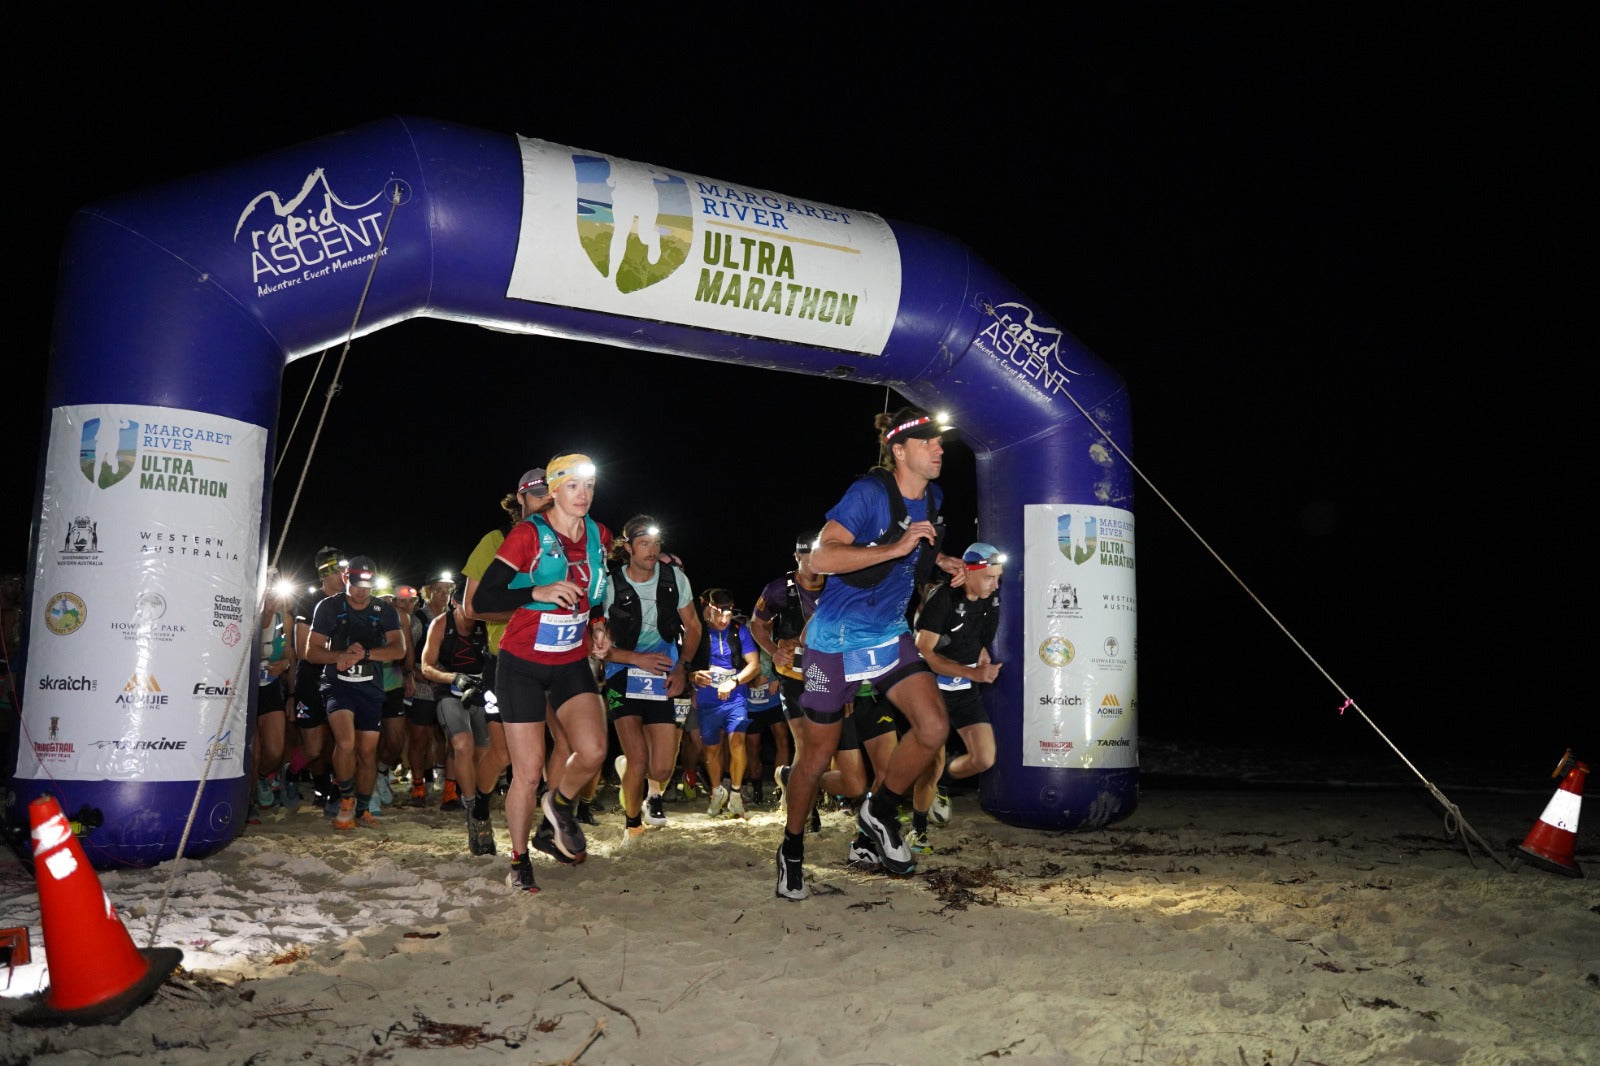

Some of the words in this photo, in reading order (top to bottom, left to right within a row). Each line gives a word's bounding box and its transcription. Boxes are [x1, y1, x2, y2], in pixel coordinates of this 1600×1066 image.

[695, 181, 851, 225] MARGARET
[251, 193, 338, 249] rapid
[702, 197, 789, 230] RIVER
[251, 212, 382, 283] ASCENT
[702, 230, 796, 280] ULTRA
[257, 276, 302, 298] Adventure
[303, 265, 330, 282] Event
[332, 247, 390, 274] Management
[694, 268, 858, 327] MARATHON
[1001, 314, 1057, 357] rapid
[972, 338, 1001, 362] Adventure
[1000, 360, 1018, 376] Event
[980, 321, 1070, 394] ASCENT
[144, 423, 232, 446] MARGARET
[143, 436, 193, 451] RIVER
[141, 455, 194, 476] ULTRA
[139, 473, 228, 499] MARATHON
[140, 531, 224, 547] WESTERN
[1100, 527, 1123, 537] RIVER
[140, 544, 239, 561] AUSTRALIA
[1100, 541, 1124, 555] ULTRA
[214, 595, 241, 606] Cheeky
[214, 603, 242, 614] Monkey
[212, 619, 225, 628] Co.
[213, 612, 242, 623] Brewing
[161, 623, 186, 632] PARK
[557, 625, 577, 641] 12
[867, 650, 876, 666] 1
[347, 664, 363, 674] 31
[39, 675, 91, 691] skratch
[192, 680, 236, 696] FENI
[643, 678, 653, 690] 2
[112, 737, 188, 750] TRKINE
[1097, 737, 1131, 747] TARKINE
